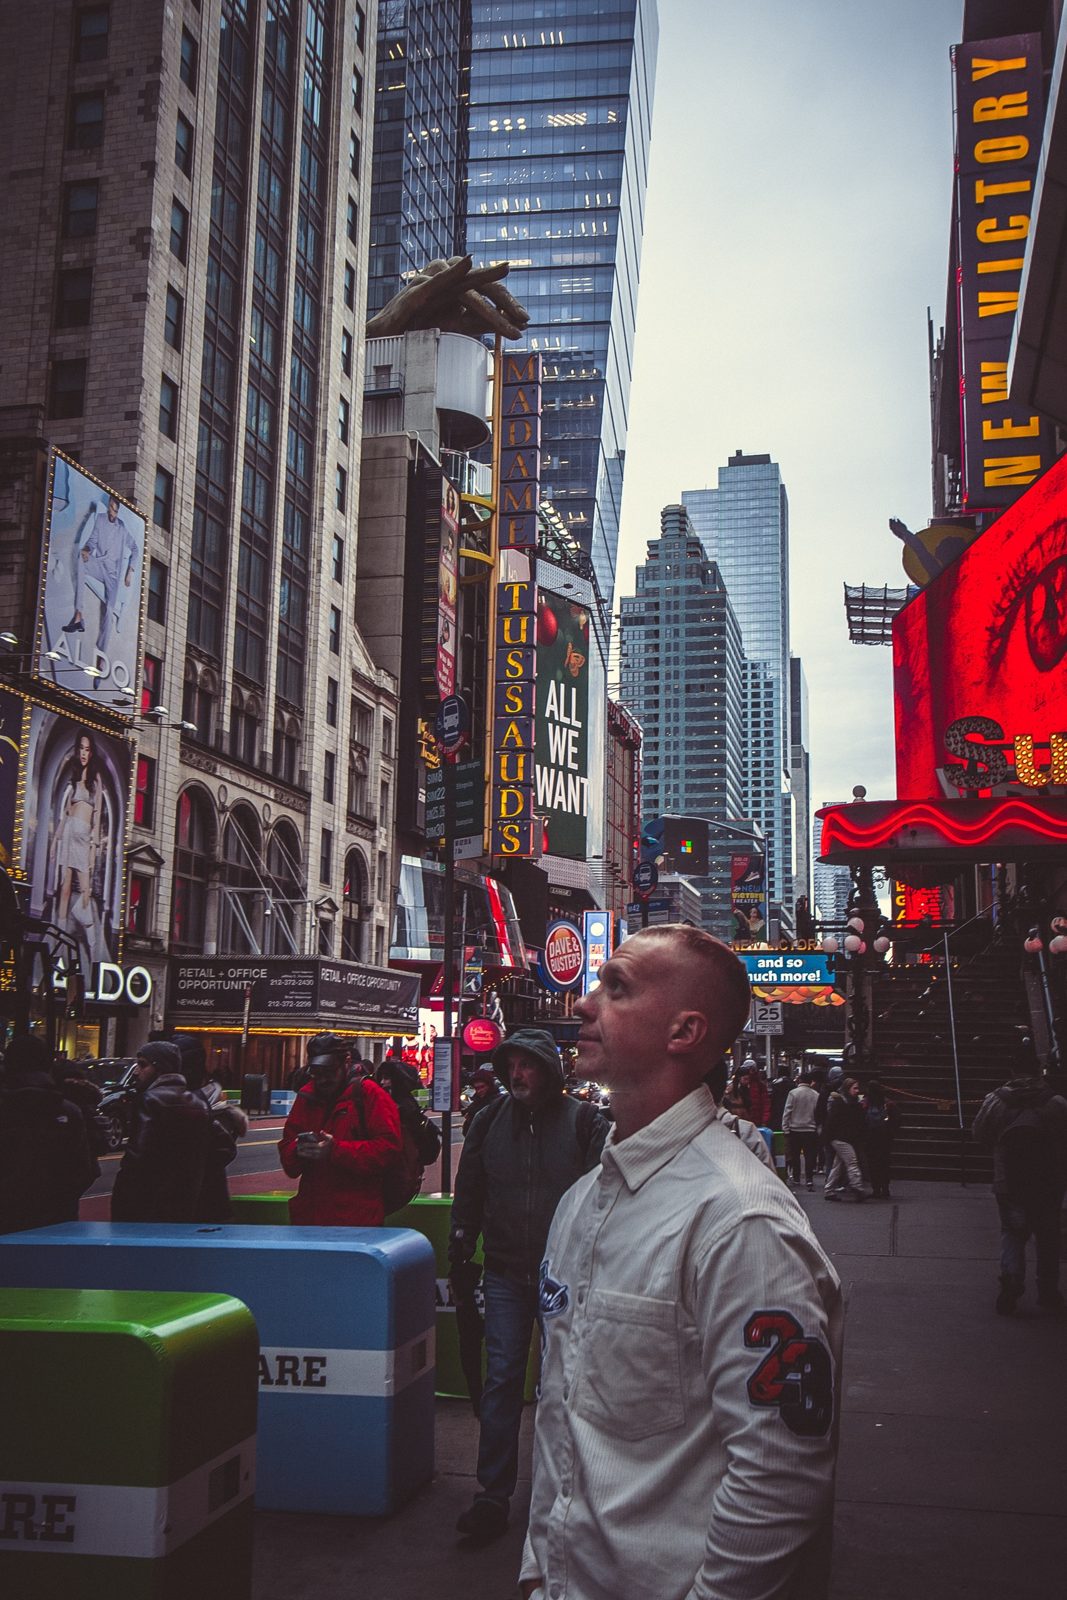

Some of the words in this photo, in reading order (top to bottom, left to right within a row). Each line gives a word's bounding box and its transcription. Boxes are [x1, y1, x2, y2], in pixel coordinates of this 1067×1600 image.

[971, 56, 1031, 318] VICTORY
[504, 355, 534, 545] MADAME
[52, 632, 129, 688] ALDO
[545, 679, 582, 729] ALL
[548, 722, 579, 771] WE
[535, 764, 589, 817] WANT
[549, 938, 571, 958] DAVE
[571, 936, 580, 952] &
[757, 956, 784, 968] and
[786, 958, 803, 968] so
[53, 956, 152, 1004] ADO
[178, 968, 216, 978] RETAIL
[227, 968, 268, 978] OFFICE
[178, 980, 256, 990] OPPORTUNITY
[321, 967, 342, 983] RETAIL
[346, 972, 366, 987] OFFICE
[366, 976, 402, 992] OPPORTUNITY
[780, 969, 821, 982] more!
[758, 1008, 779, 1020] 25
[0, 1492, 76, 1543] RE
